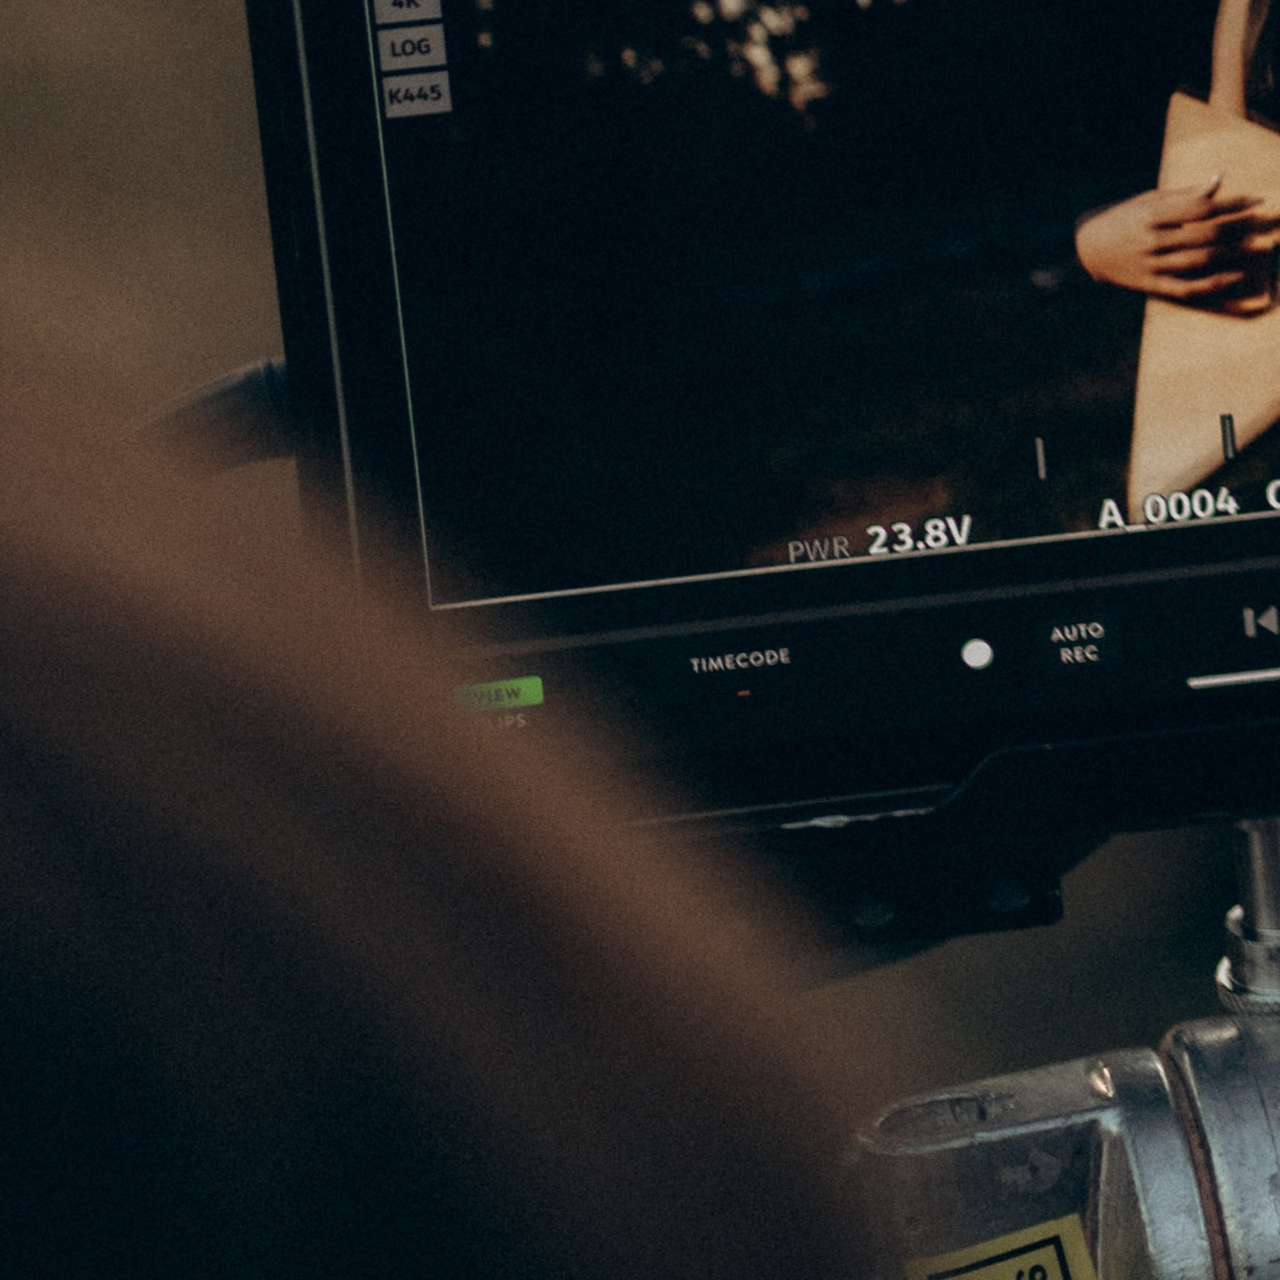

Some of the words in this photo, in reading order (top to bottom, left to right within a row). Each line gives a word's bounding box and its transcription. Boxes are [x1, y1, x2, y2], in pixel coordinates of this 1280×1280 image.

[390, 37, 431, 58] LOG
[388, 84, 443, 106] K445
[787, 535, 851, 565] PWR
[865, 514, 972, 557] 23.8V
[1050, 621, 1105, 644] AUTO
[690, 647, 791, 674] TIMECODE
[1060, 644, 1100, 664] REC
